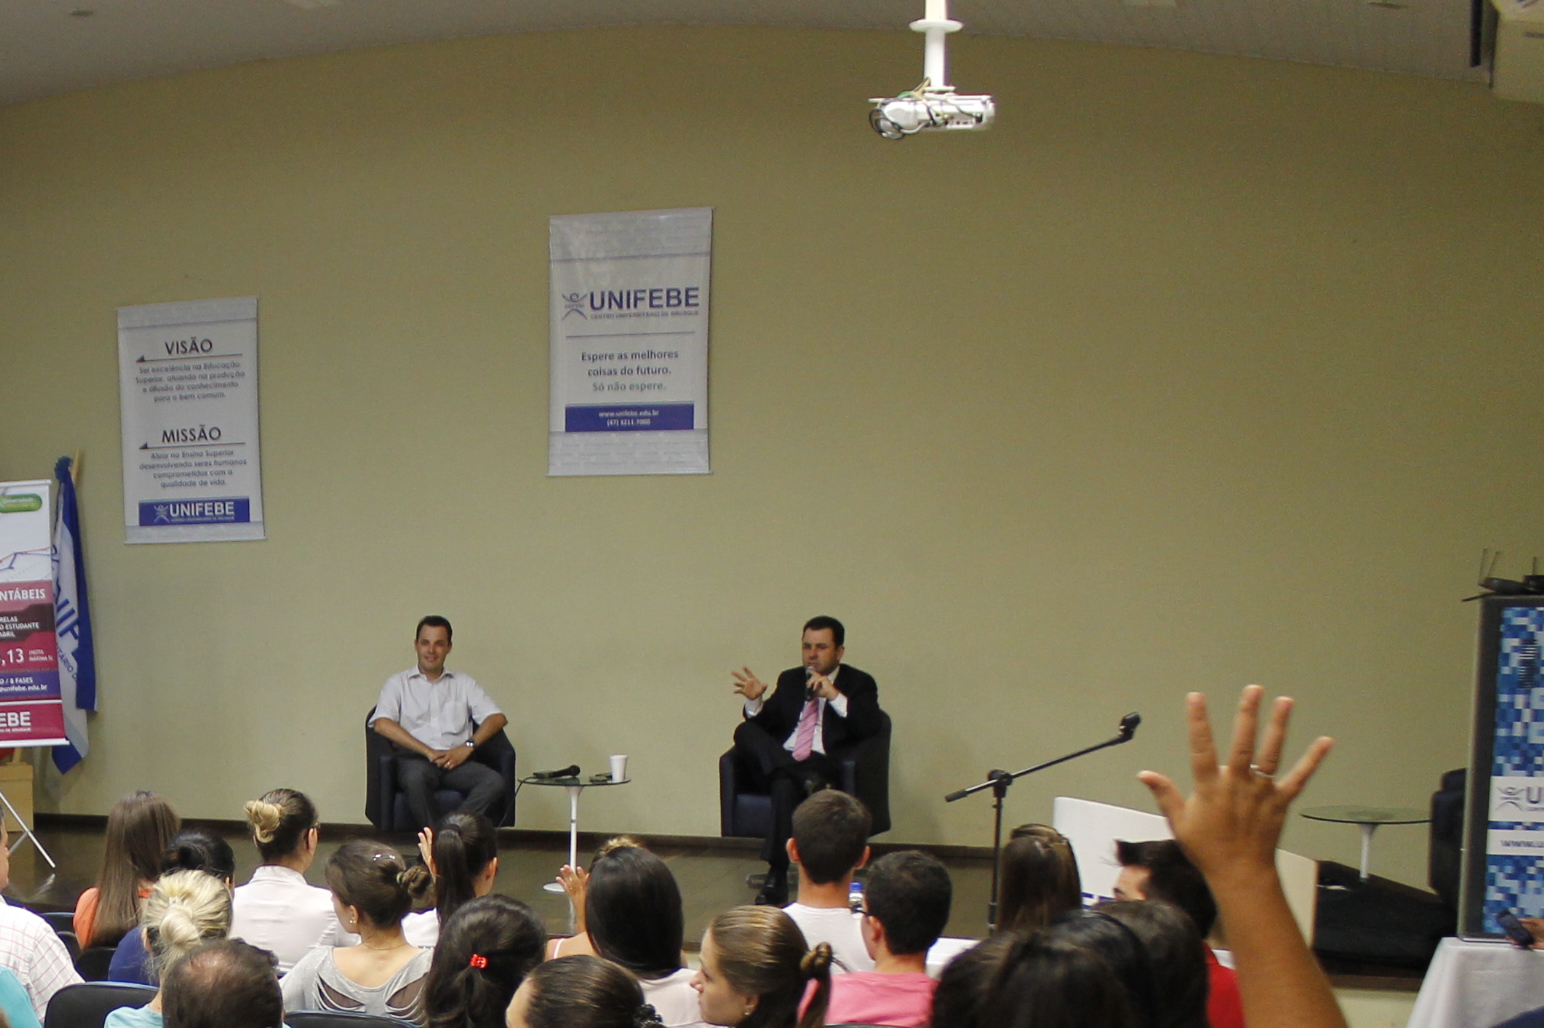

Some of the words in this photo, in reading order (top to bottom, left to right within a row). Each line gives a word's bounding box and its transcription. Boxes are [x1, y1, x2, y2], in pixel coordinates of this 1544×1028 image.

[590, 287, 699, 310] UNIFEBE
[164, 336, 213, 355] VISÃO
[581, 351, 614, 362] Espere
[617, 352, 628, 360] as
[631, 349, 678, 360] melhores
[588, 366, 617, 376] coisas
[620, 366, 633, 375] do
[636, 365, 671, 375] futuro.
[593, 382, 605, 391] Só
[608, 381, 626, 391] não
[629, 382, 666, 392] espere.
[162, 424, 222, 443] MISSÃO
[205, 450, 234, 458] Superior
[139, 462, 192, 470] desenvolvendo
[153, 470, 208, 479] comprometidos
[161, 480, 196, 489] qualidade
[170, 501, 234, 517] UNIFEBE
[5, 622, 40, 630] ESTUDANTE
